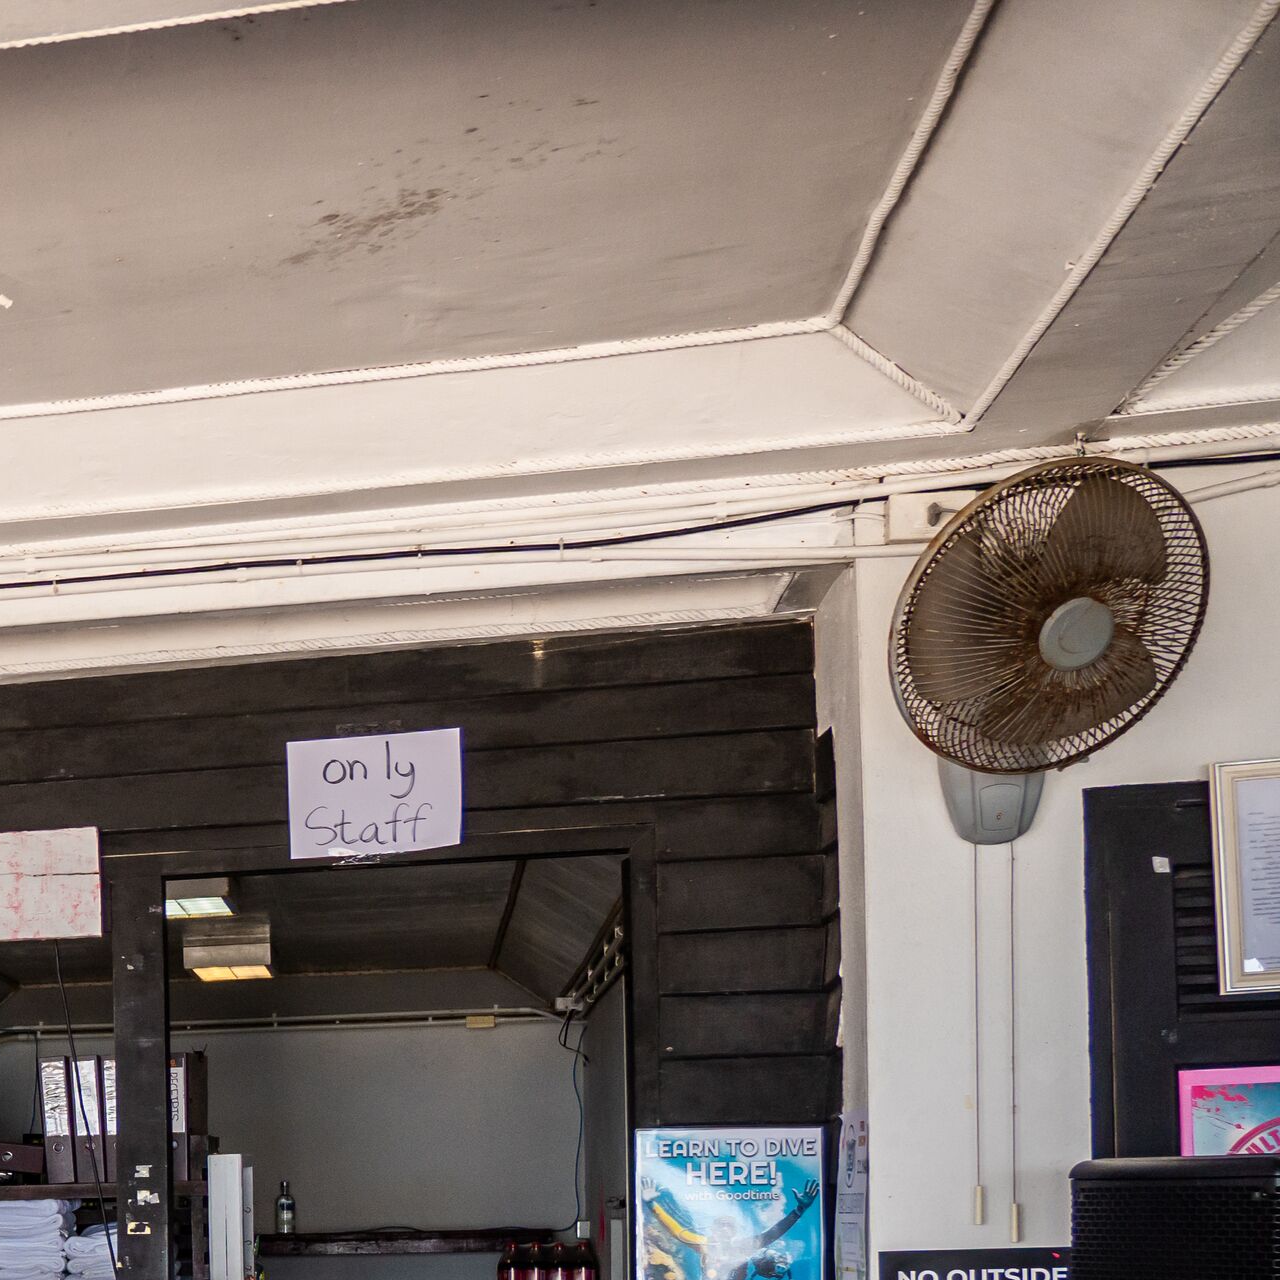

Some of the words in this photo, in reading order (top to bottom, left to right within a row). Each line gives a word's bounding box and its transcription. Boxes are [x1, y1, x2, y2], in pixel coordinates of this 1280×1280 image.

[304, 802, 433, 846] Staff
[645, 1138, 719, 1158] LEARN
[725, 1138, 759, 1158] TO
[765, 1137, 817, 1158] DIVE
[685, 1161, 778, 1187] HERE!
[715, 1188, 780, 1201] Goodtime
